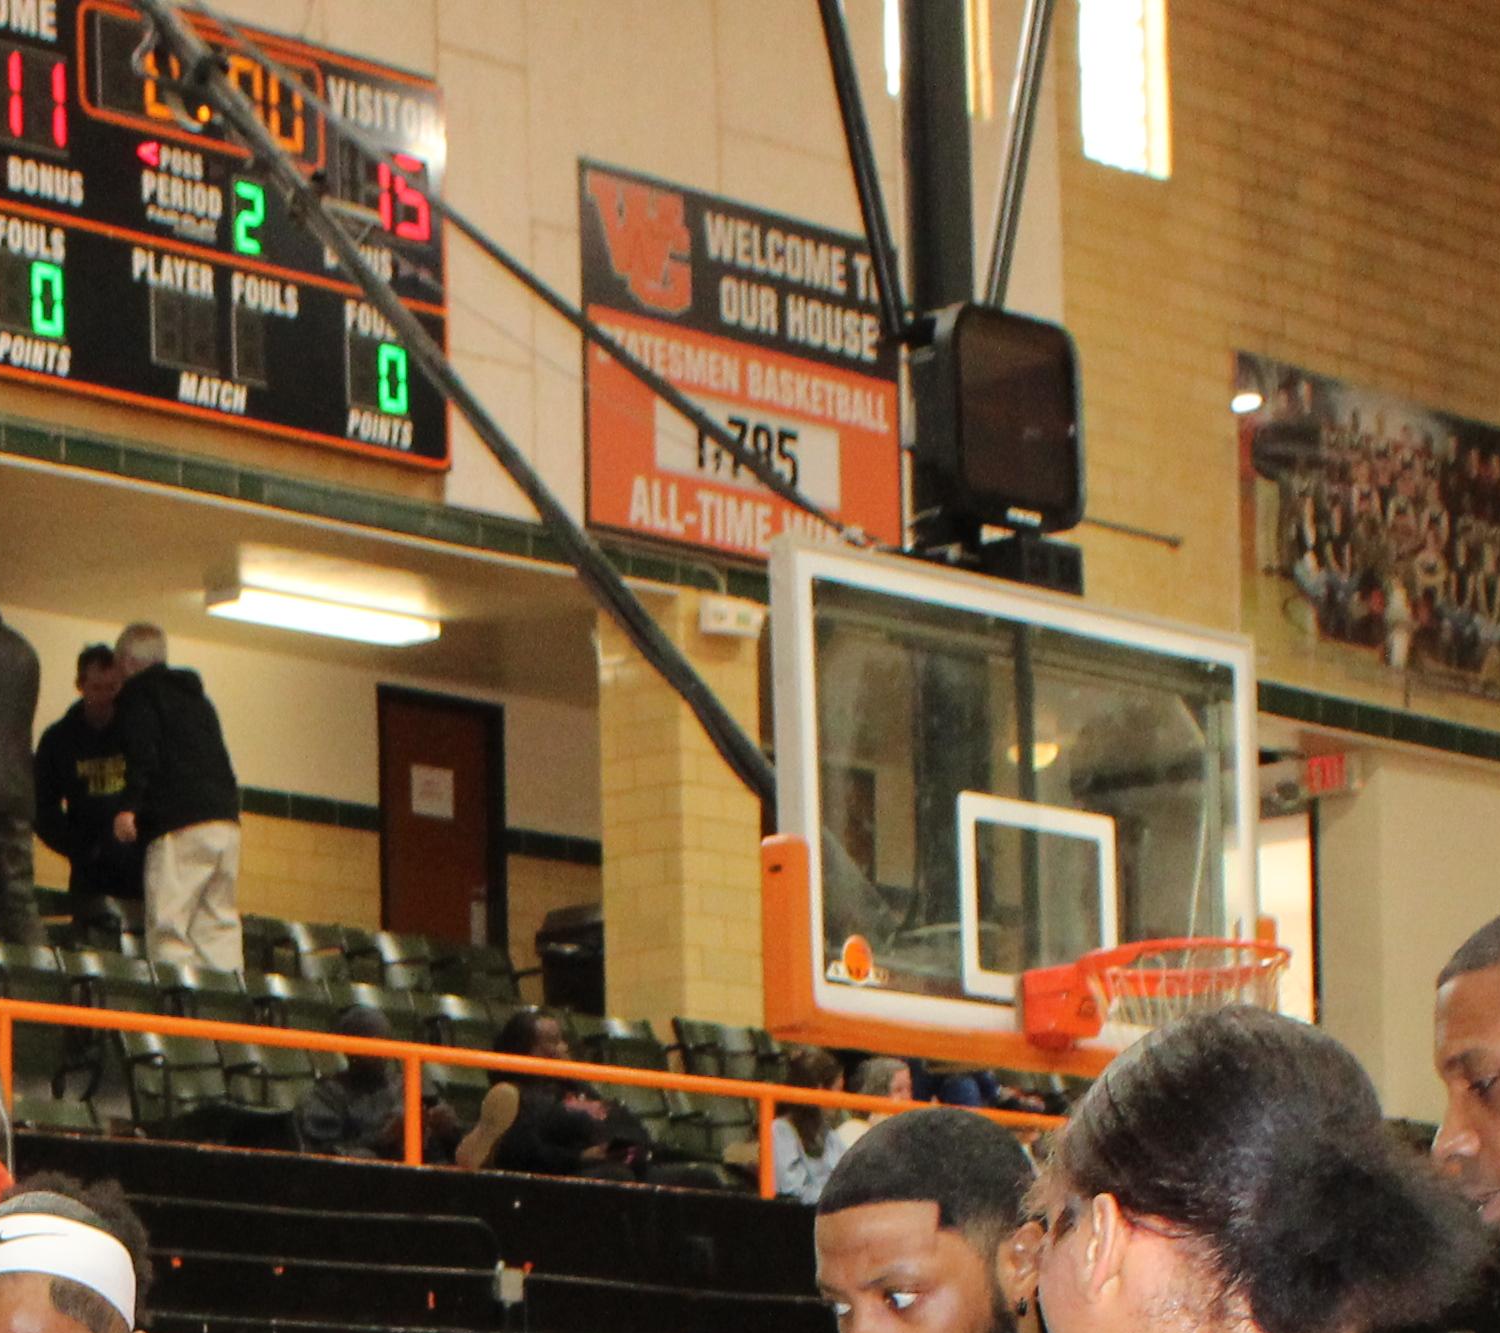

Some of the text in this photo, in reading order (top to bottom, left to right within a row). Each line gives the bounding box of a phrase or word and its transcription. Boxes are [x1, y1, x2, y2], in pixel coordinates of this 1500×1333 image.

[7, 50, 68, 149] 11
[7, 155, 84, 208] BONUS
[142, 169, 224, 221] PERIOD
[233, 180, 265, 255] 2
[377, 154, 431, 242] 15
[132, 246, 299, 319] PLAYER FOULS
[704, 209, 848, 296] WELCOME
[30, 260, 65, 338] 0
[345, 298, 398, 343] FOUL
[719, 275, 882, 362] OUR HOUSE
[177, 370, 248, 415] MATCH
[377, 342, 409, 415] 0
[747, 358, 891, 435] BASKETBALL
[346, 407, 414, 450] POINTS
[627, 474, 774, 553] ALL-TIME
